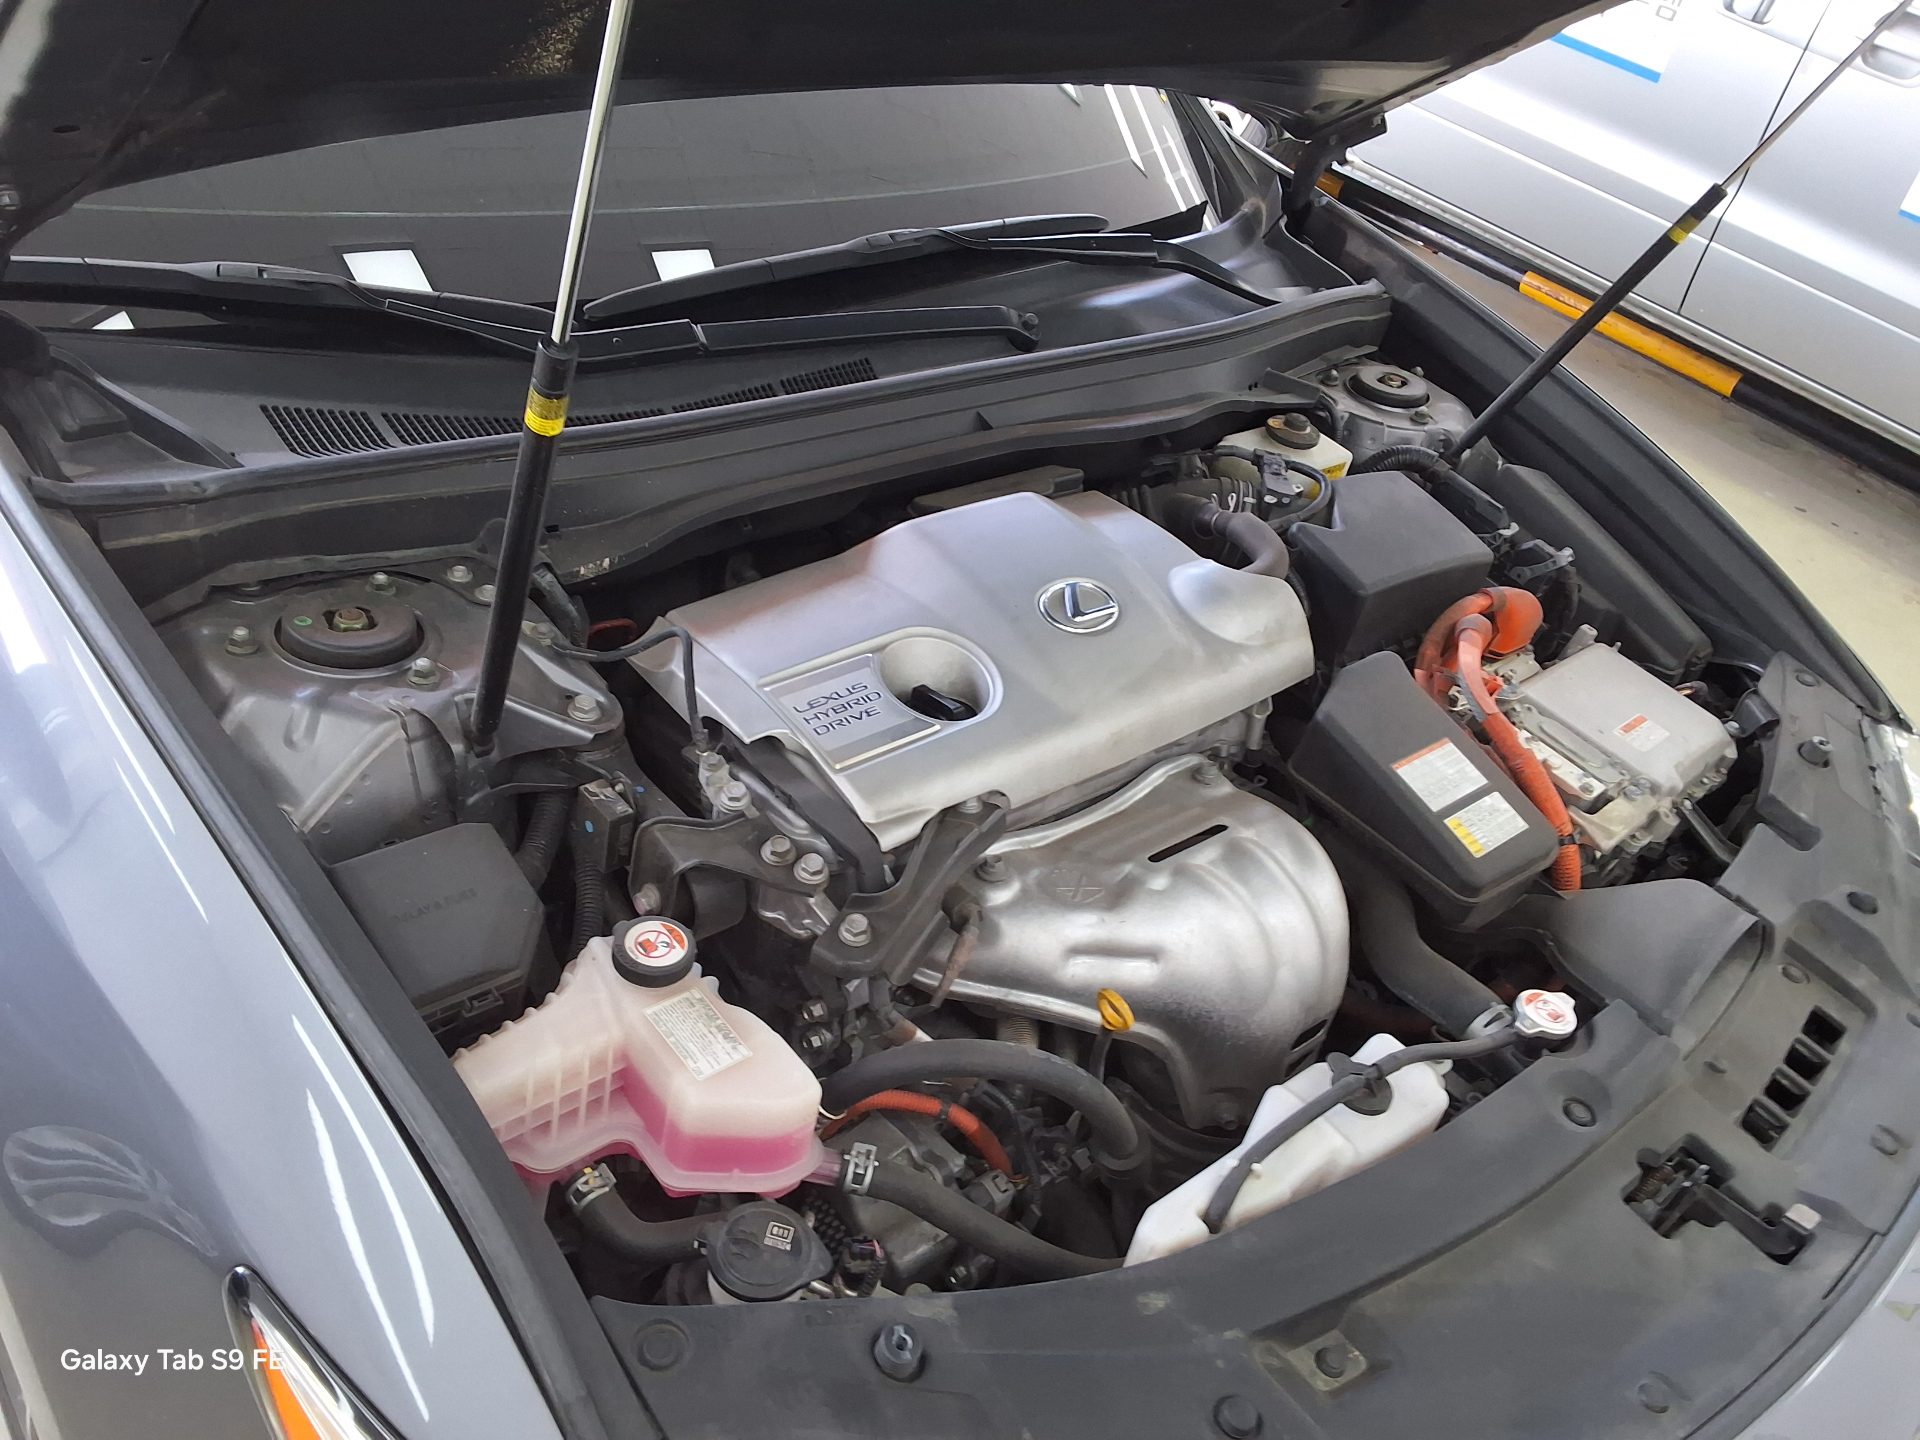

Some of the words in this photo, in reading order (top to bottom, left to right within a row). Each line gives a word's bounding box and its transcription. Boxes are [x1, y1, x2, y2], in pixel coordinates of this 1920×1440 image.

[792, 682, 868, 713] LEXUS
[803, 691, 882, 724] HYBRID
[812, 705, 882, 736] DRIVE
